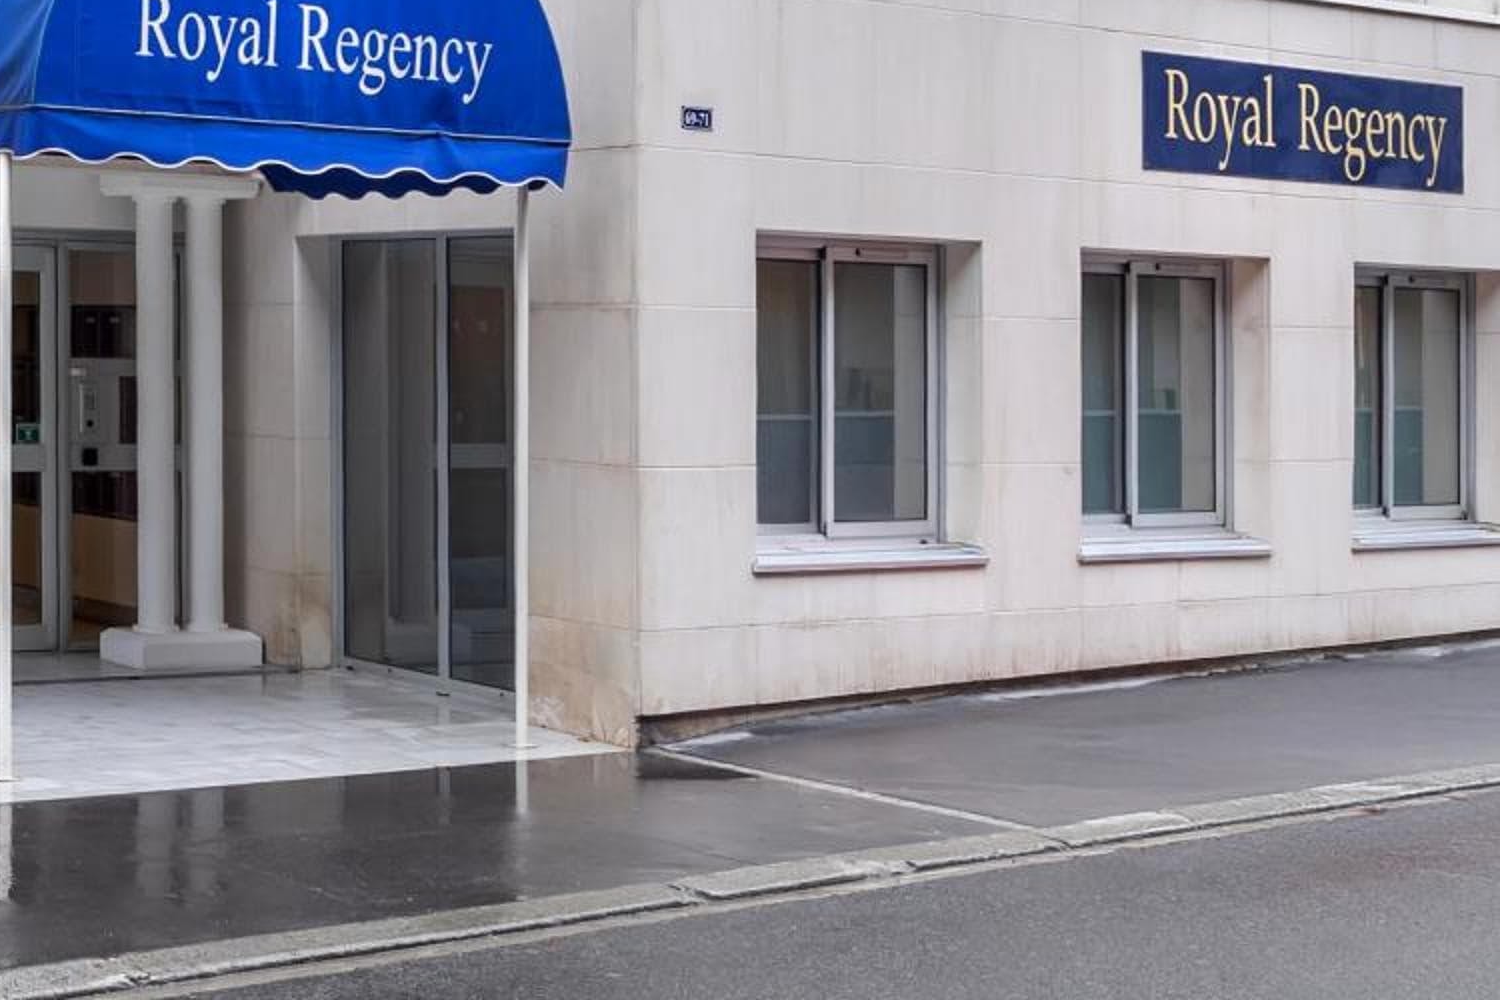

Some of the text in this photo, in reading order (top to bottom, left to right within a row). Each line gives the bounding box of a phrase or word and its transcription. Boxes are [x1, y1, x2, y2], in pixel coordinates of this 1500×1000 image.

[296, 3, 493, 104] Regency
[1163, 68, 1447, 187] Royal Regency
